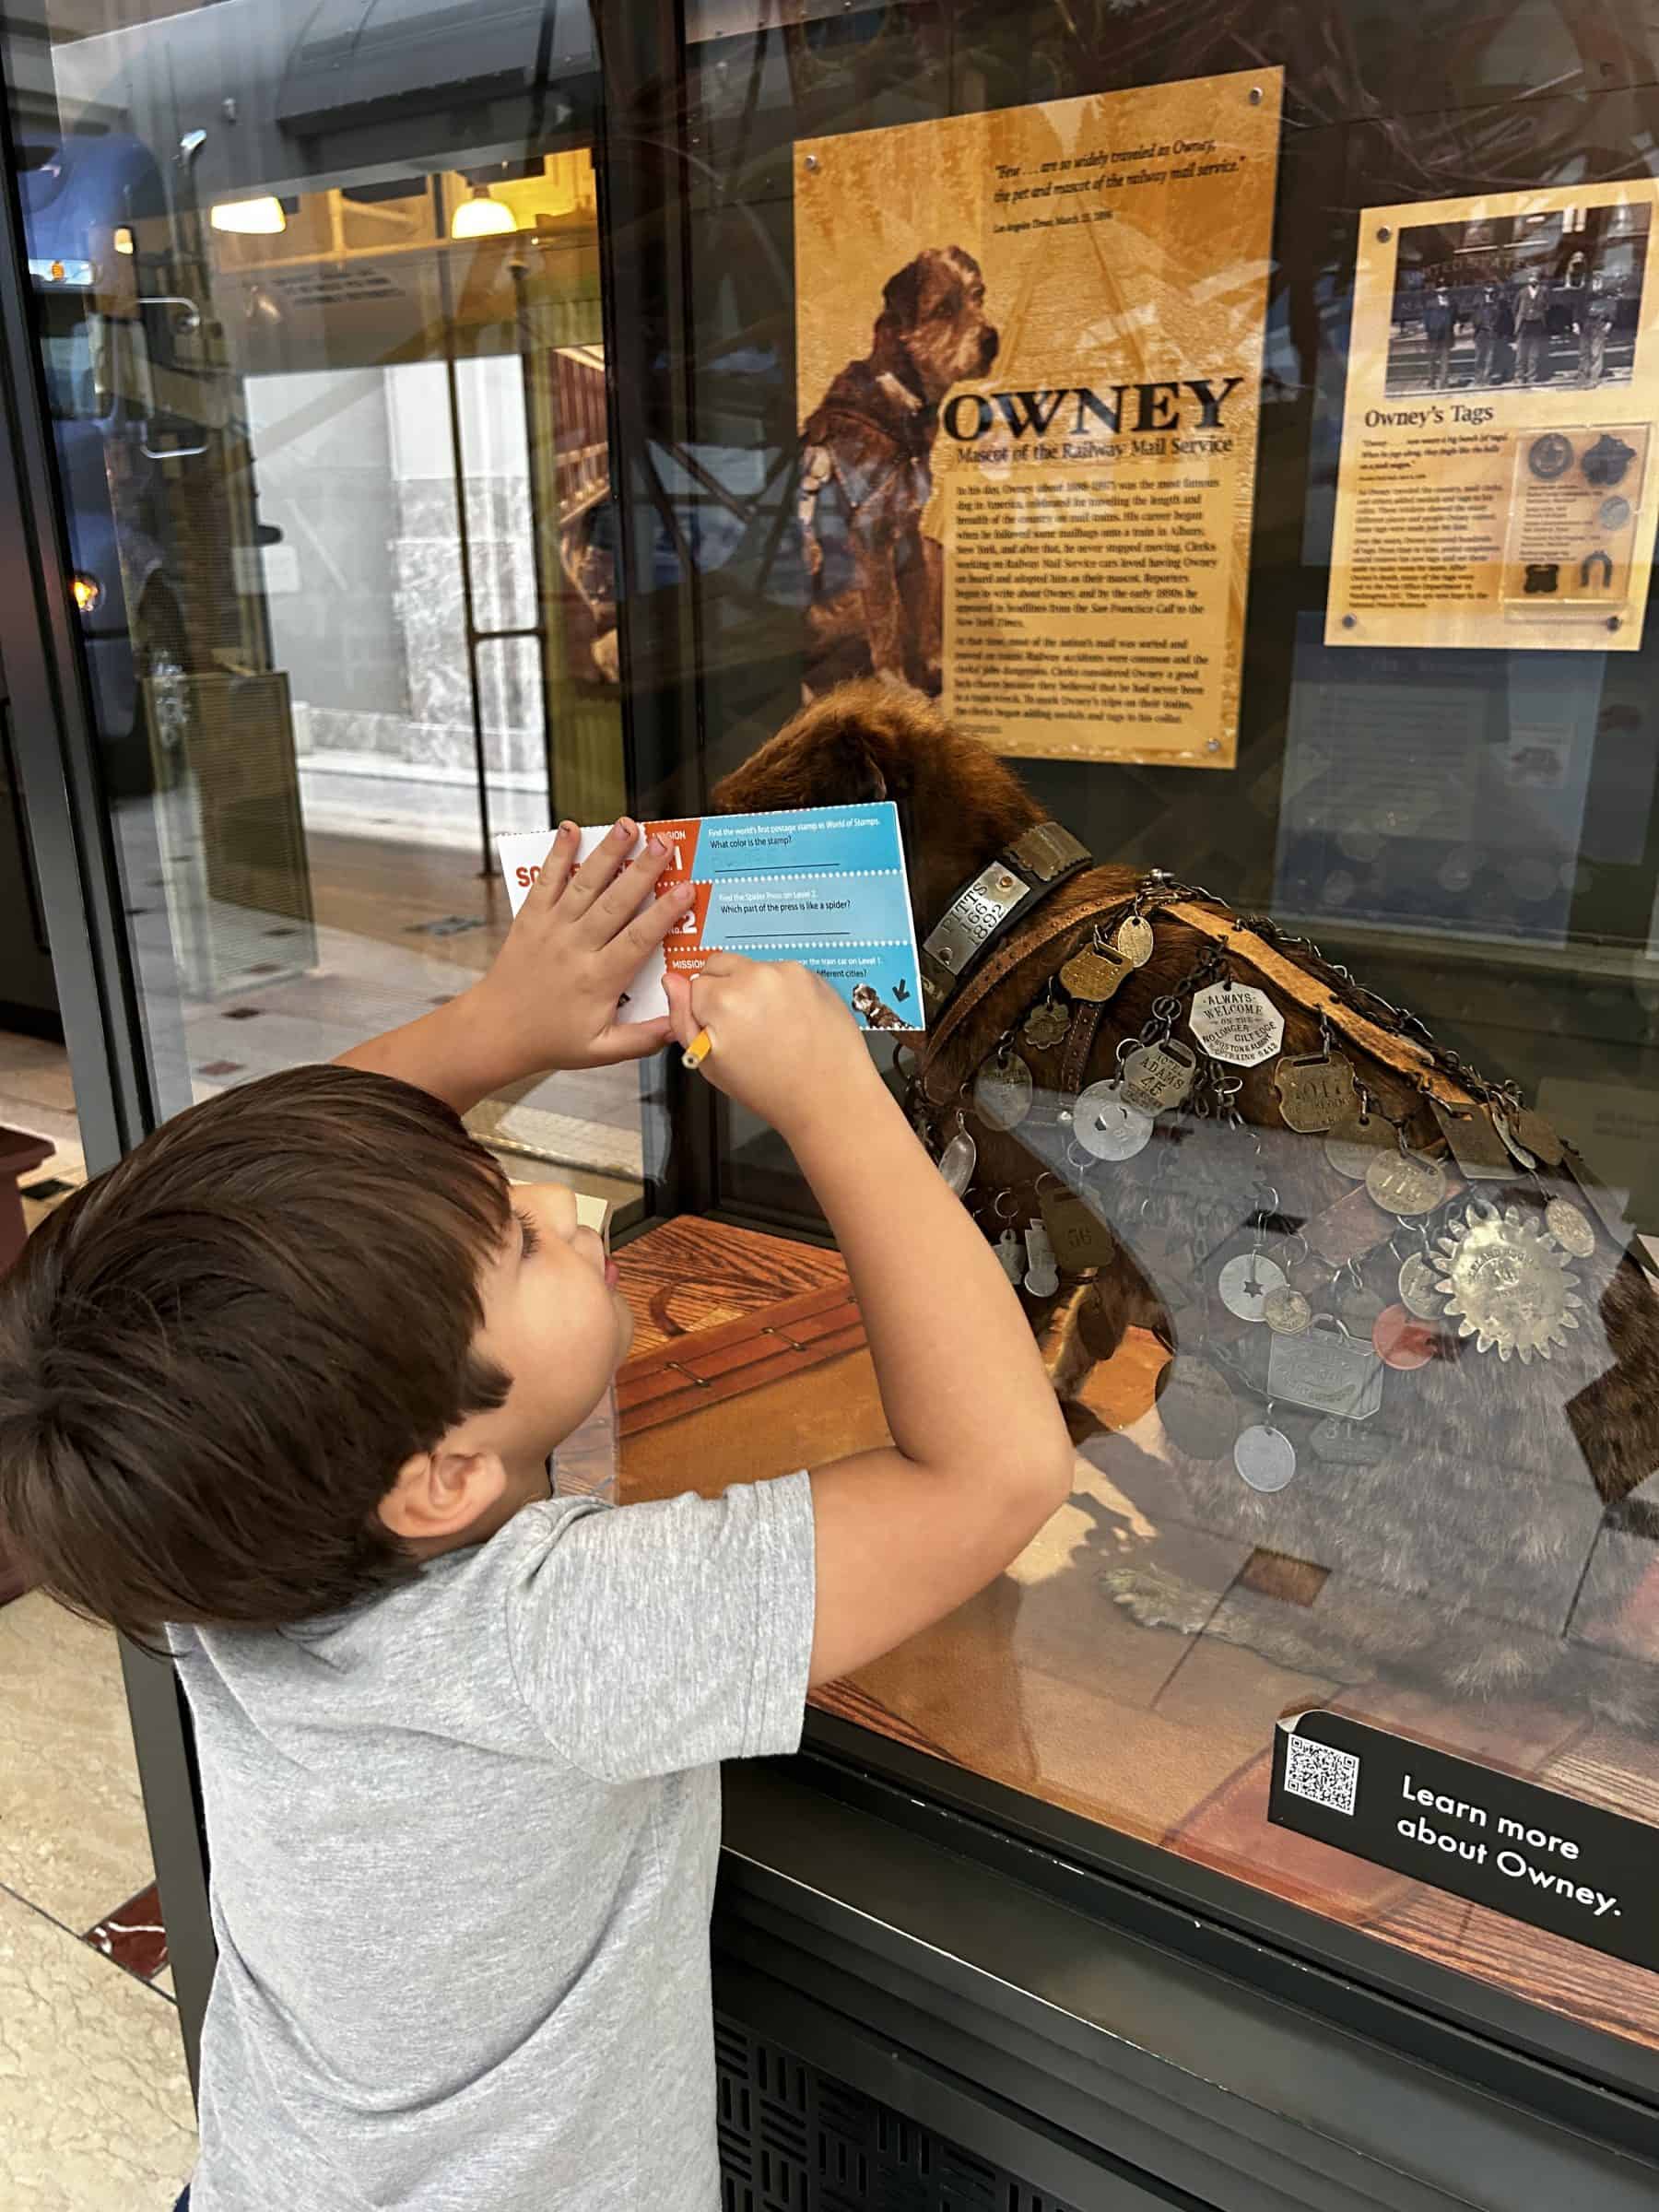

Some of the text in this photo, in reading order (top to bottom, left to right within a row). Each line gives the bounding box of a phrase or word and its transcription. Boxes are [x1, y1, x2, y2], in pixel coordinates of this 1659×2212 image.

[1074, 150, 1108, 169] widely
[1031, 182, 1052, 197] and
[1171, 162, 1196, 179] mail
[944, 377, 1244, 441] OWNEY
[1451, 405, 1494, 426] Tags
[958, 435, 1233, 463] Mascot of the Railway Mail Service
[709, 828, 723, 837] Find
[724, 827, 734, 835] the
[826, 818, 845, 829] World
[846, 818, 853, 827] of
[854, 818, 881, 828] Stamps.
[710, 834, 792, 848] What color is the stamp?
[734, 892, 745, 900] the
[793, 891, 811, 900] Level
[722, 904, 742, 913] Which
[744, 904, 758, 914] part
[759, 904, 766, 912] of
[767, 903, 779, 912] the
[780, 903, 798, 913] press
[806, 901, 818, 910] like
[826, 900, 851, 912] spider?
[941, 882, 988, 934] PITTS
[959, 902, 988, 933] 166
[968, 904, 1005, 947] 1892
[858, 957, 876, 965] Level
[845, 967, 867, 978] cities?
[1208, 993, 1253, 1005] ALWAYS
[1203, 1004, 1263, 1019] WELCOME
[1140, 1056, 1184, 1089] ADAMS
[1141, 1077, 1166, 1096] 45
[1402, 1774, 1580, 1860] Learn more
[1397, 1817, 1621, 1916] about Owney.
